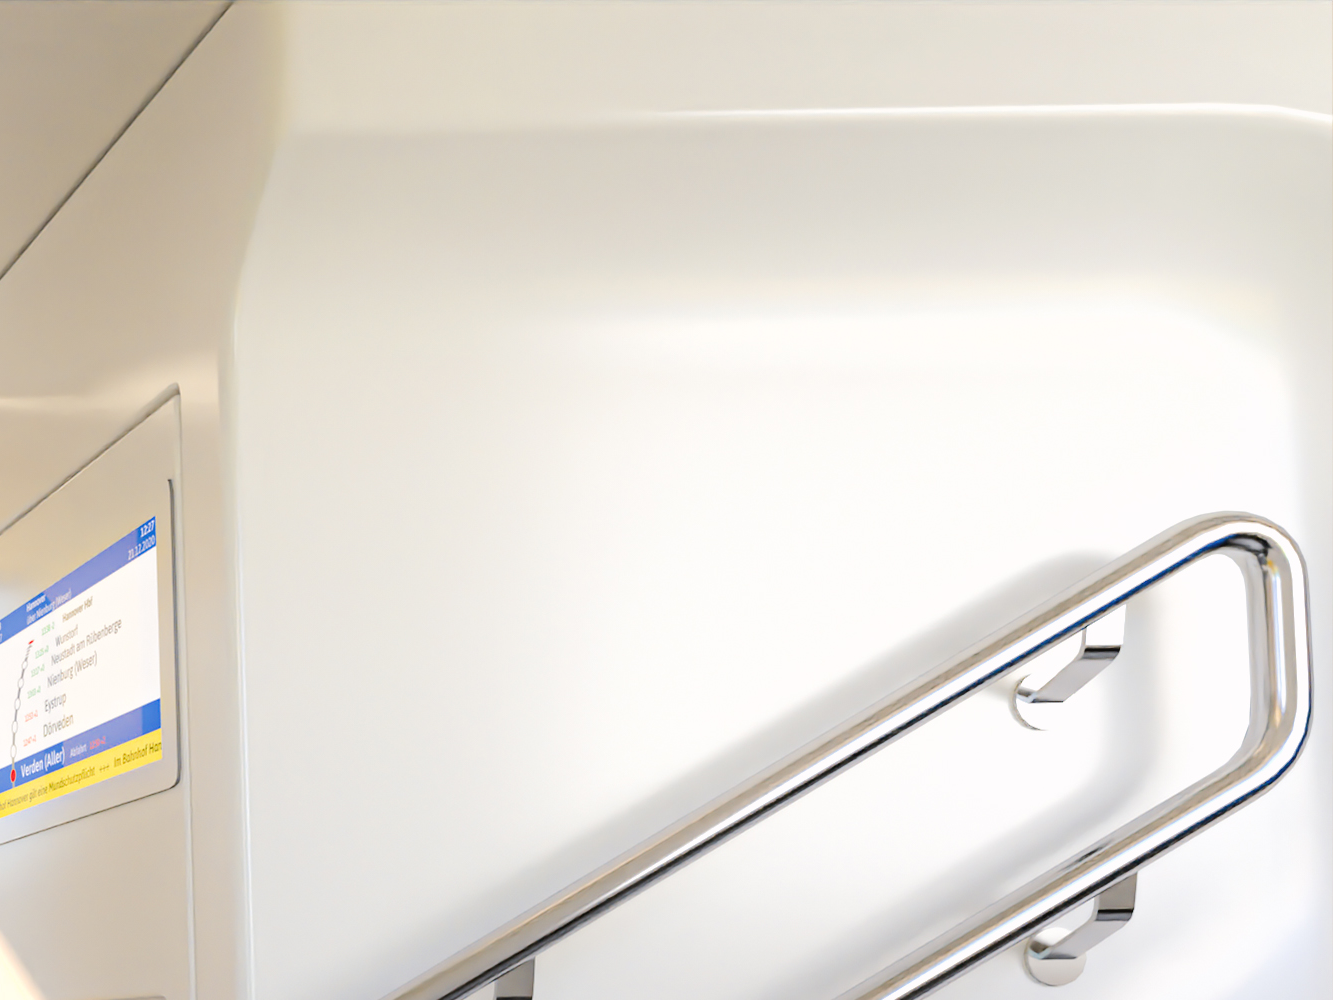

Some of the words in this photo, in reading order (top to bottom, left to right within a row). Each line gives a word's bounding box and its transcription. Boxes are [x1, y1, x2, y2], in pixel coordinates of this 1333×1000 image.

[62, 604, 83, 622] Hannover
[51, 644, 75, 666] Neustadt
[76, 640, 85, 652] am
[86, 619, 122, 646] Rübenberge
[55, 624, 78, 646] Wunstorf
[47, 666, 73, 688] Nienburg
[74, 650, 97, 676] (Weser)
[45, 693, 66, 714] Eystrup
[20, 759, 43, 778] Verden
[44, 746, 65, 771] (Aller)
[123, 744, 148, 764] Bahnhof
